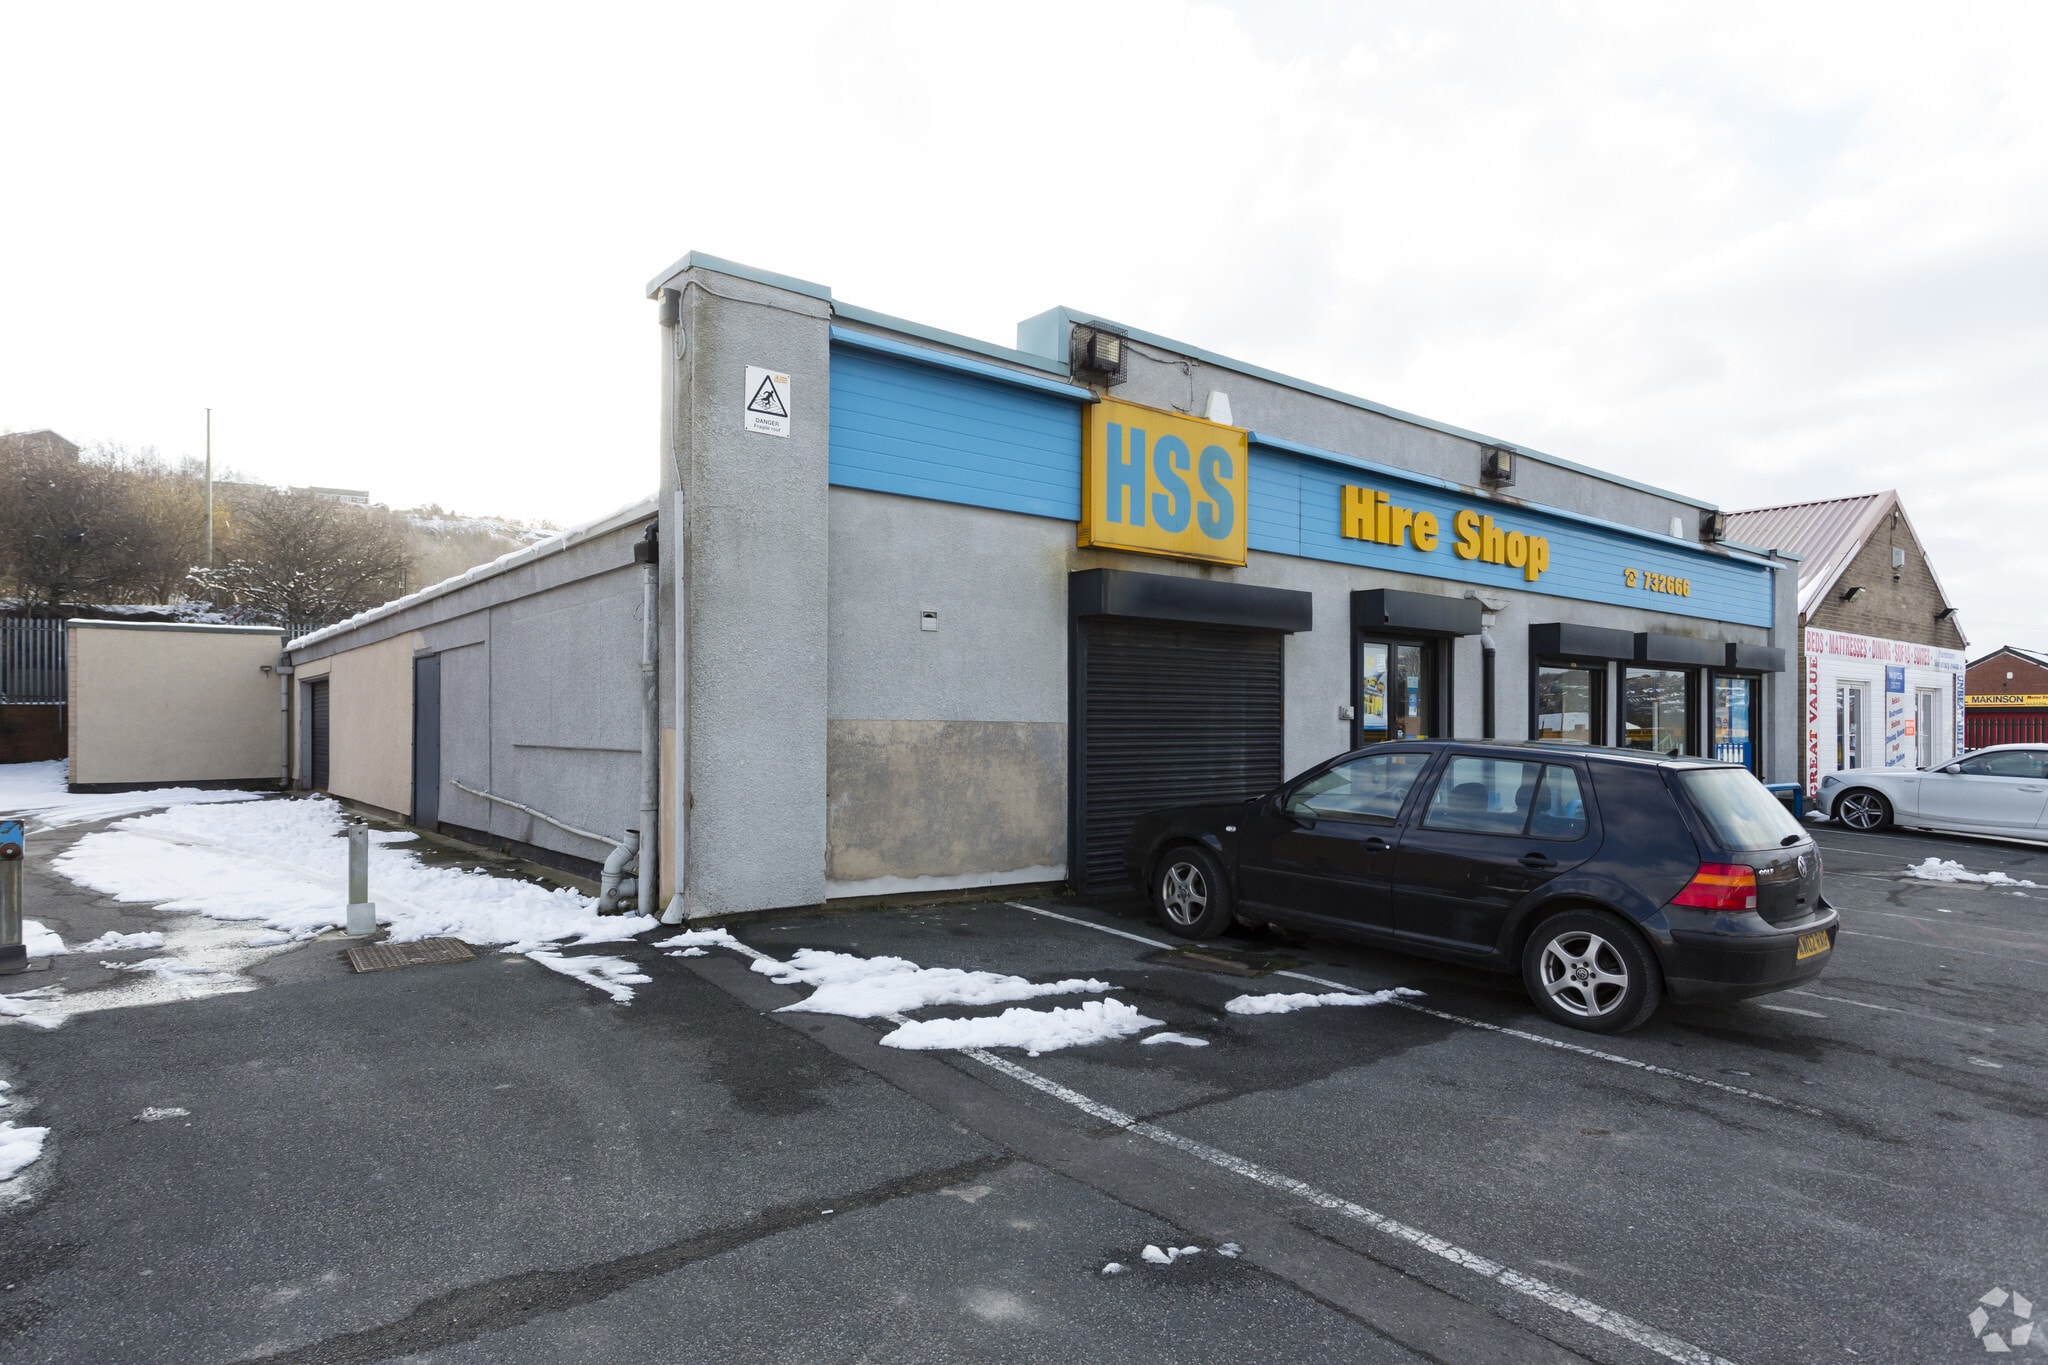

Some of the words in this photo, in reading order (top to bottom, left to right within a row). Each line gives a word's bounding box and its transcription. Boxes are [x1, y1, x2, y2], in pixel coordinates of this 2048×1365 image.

[753, 423, 770, 431] Fragile
[755, 417, 780, 427] DANGER
[1106, 421, 1235, 540] HSS
[1341, 484, 1440, 552] Hire
[1452, 509, 1549, 582] Shop
[1643, 571, 1691, 598] 732666
[1806, 630, 1824, 654] BEDS
[1828, 633, 1868, 659] MATTRESSES
[1871, 639, 1892, 661] DINING
[1894, 643, 1911, 664] SOFAS
[1913, 646, 1931, 666] SUITES
[1809, 656, 1818, 723] VALUE
[1956, 674, 1964, 745] UNBEATABLE
[1971, 695, 2024, 704] MAKINSON
[1809, 729, 1818, 801] GREAT
